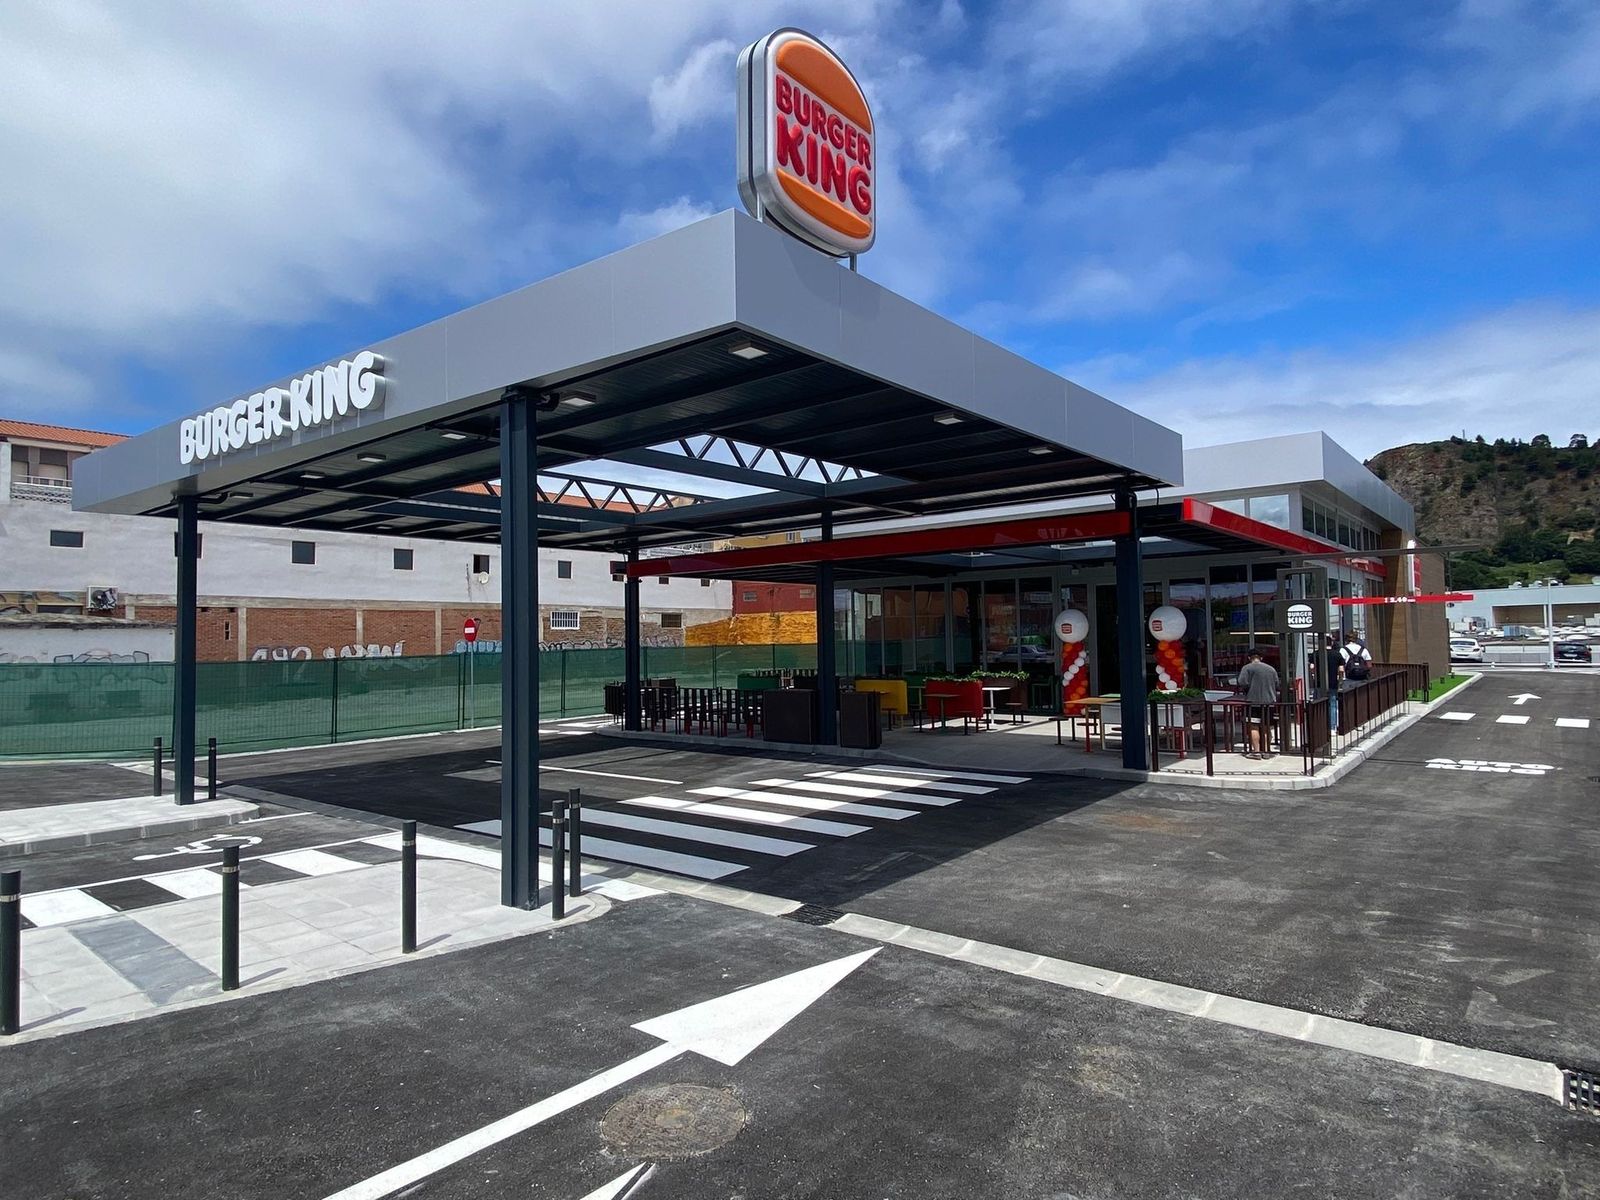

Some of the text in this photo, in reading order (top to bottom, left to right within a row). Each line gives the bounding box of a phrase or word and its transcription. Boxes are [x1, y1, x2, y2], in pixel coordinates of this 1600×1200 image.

[776, 74, 871, 171] BURGER
[776, 113, 871, 215] KING
[180, 350, 383, 465] BURGER KING
[1288, 616, 1312, 624] KING
[1425, 758, 1555, 770] AUTO
[1425, 763, 1546, 775] KING
